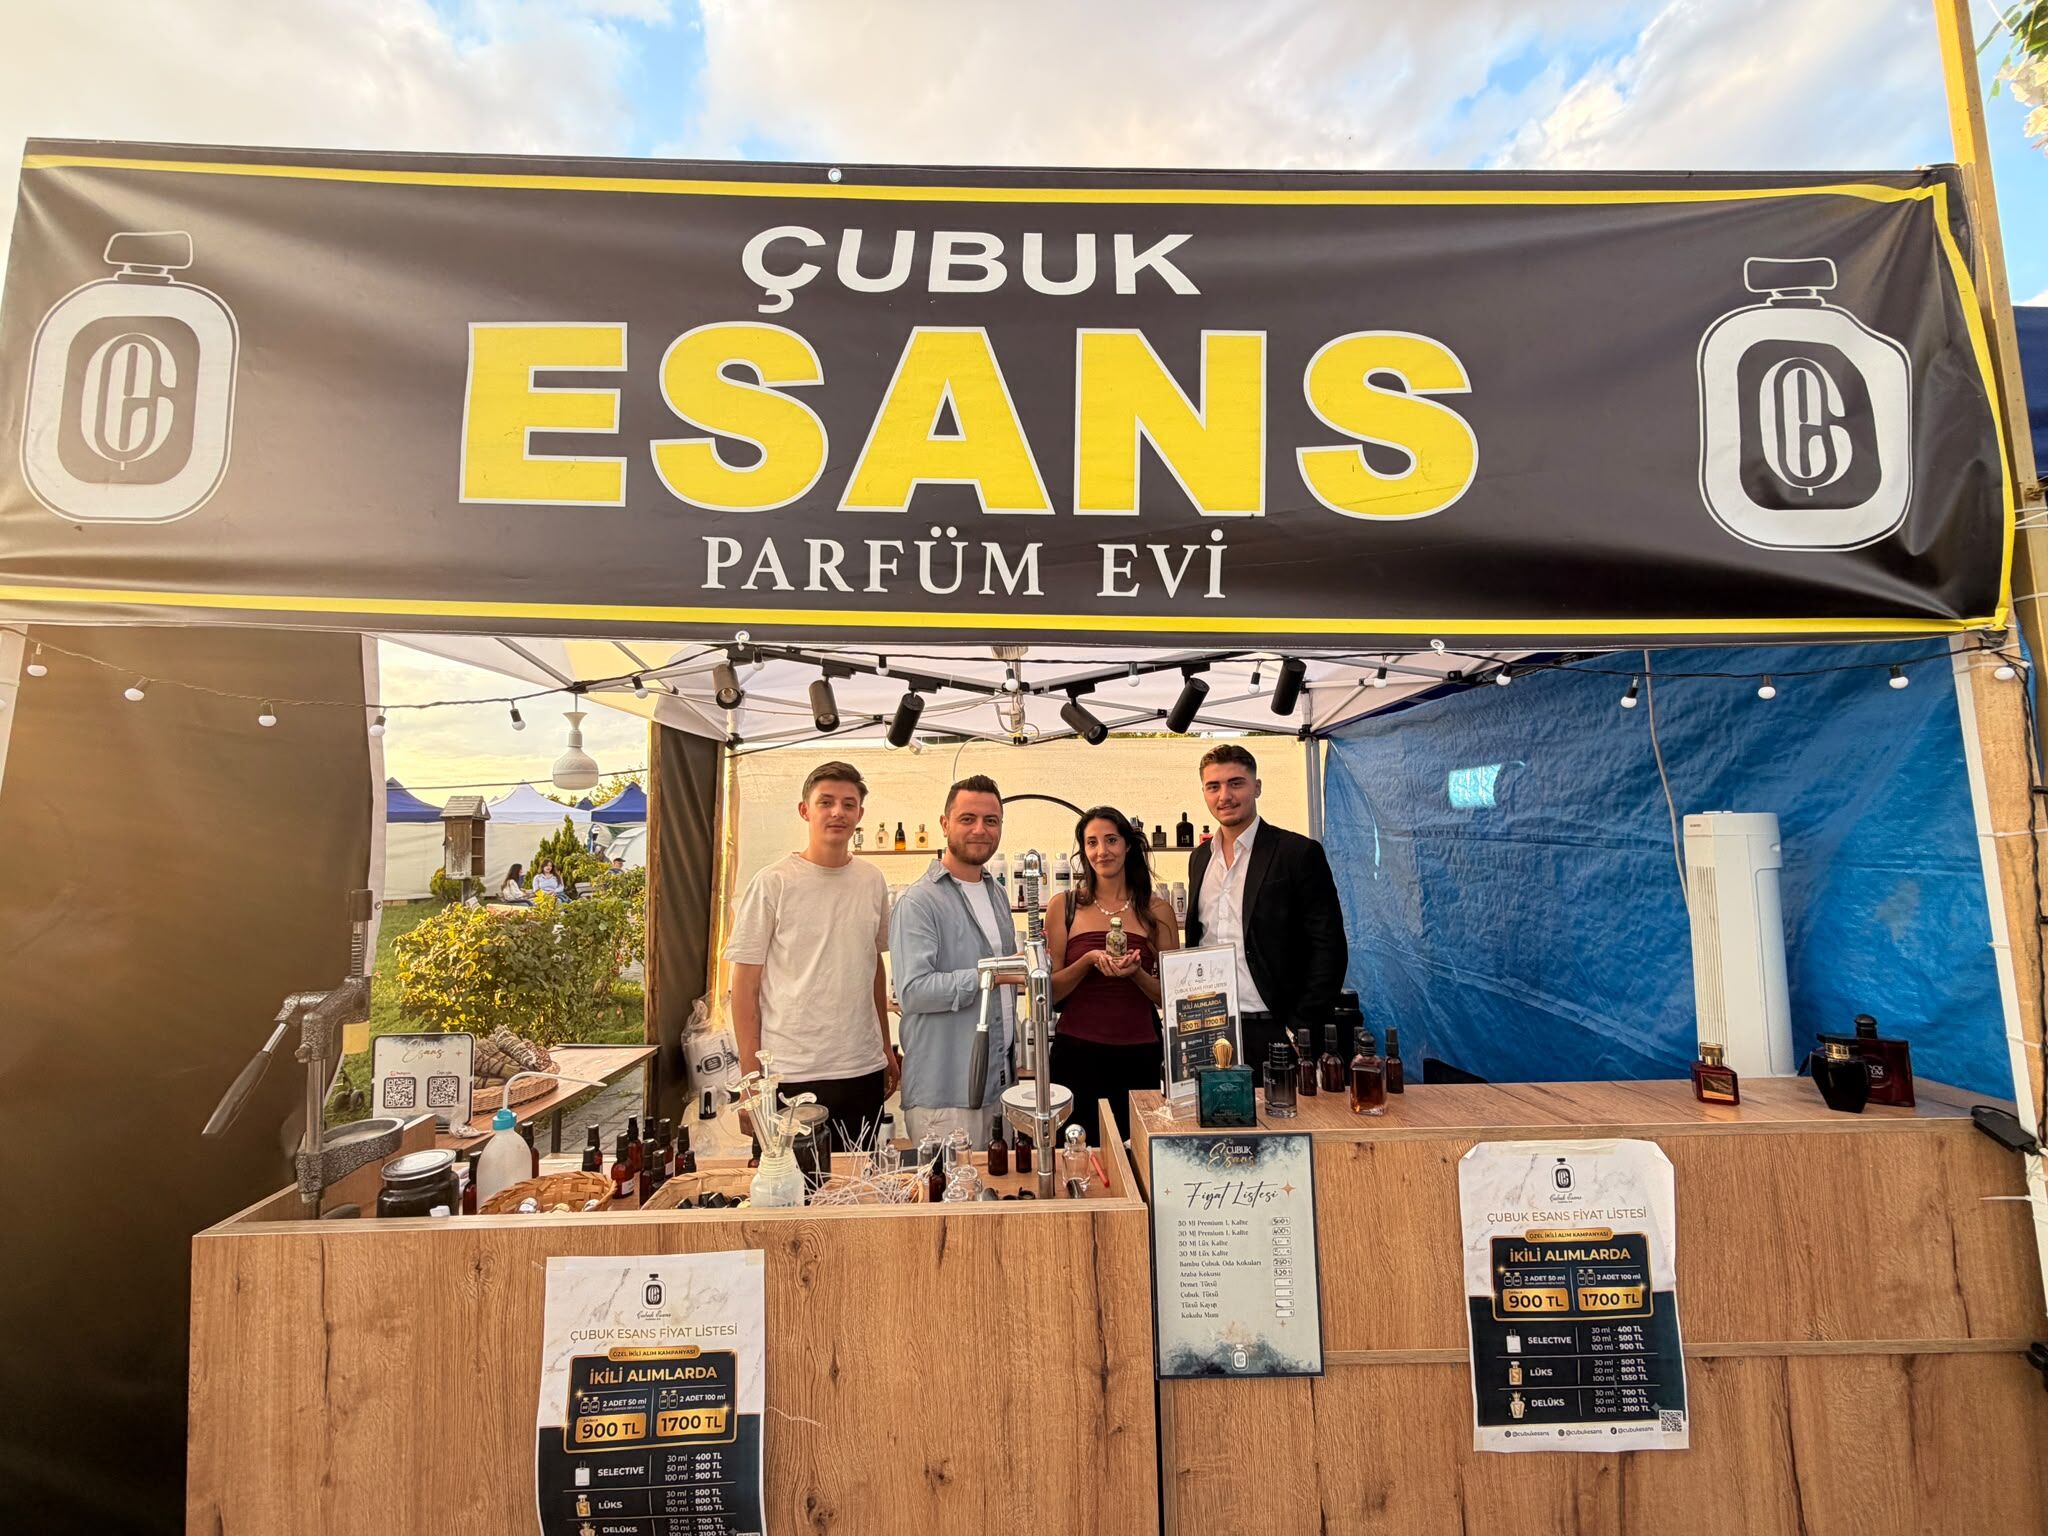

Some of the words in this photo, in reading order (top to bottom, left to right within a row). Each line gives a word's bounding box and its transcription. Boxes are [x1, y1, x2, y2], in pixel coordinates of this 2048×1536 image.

[742, 226, 1200, 313] ÇUBUK
[458, 321, 1480, 521] ESANS
[702, 526, 1045, 597] PARFÜM
[1097, 528, 1229, 599] EVİ
[1184, 1181, 1231, 1210] Fiyat
[1231, 1181, 1278, 1209] Listesi
[1487, 1211, 1530, 1225] ÇUBUK
[1532, 1210, 1571, 1222] ESANS
[1573, 1208, 1604, 1220] FİYAT
[1606, 1206, 1647, 1219] LİSTESİ
[1509, 1247, 1541, 1262] İKİLİ
[1544, 1248, 1631, 1261] ALIMLARDA
[1530, 1274, 1547, 1282] ADET
[1508, 1294, 1542, 1308] 900
[1545, 1295, 1564, 1307] TL
[1581, 1292, 1620, 1306] 1700
[1622, 1293, 1640, 1304] TL
[570, 1329, 615, 1344] ÇUBUK
[617, 1327, 657, 1339] ESANS
[659, 1325, 692, 1338] FİYAT
[695, 1322, 738, 1337] LİSTESİ
[1527, 1336, 1572, 1345] SELECTIVE
[589, 1366, 624, 1385] İKİLİ
[626, 1366, 718, 1382] ALIMLARDA
[1530, 1368, 1553, 1376] LÜKS
[608, 1399, 627, 1407] ADET
[628, 1398, 636, 1406] 50
[637, 1397, 647, 1405] ml
[685, 1394, 704, 1402] ADET
[704, 1393, 716, 1401] 100
[1531, 1397, 1565, 1407] DELÜKS
[582, 1421, 618, 1439] 900
[622, 1422, 640, 1435] TL
[661, 1415, 702, 1432] 1700
[705, 1416, 722, 1428] TL
[597, 1466, 644, 1477] SELECTIVE
[666, 1464, 676, 1472] 50
[695, 1462, 711, 1470] 500
[695, 1472, 711, 1480] 900
[598, 1500, 623, 1509] LÜKS
[602, 1525, 638, 1534] DELÜKS
